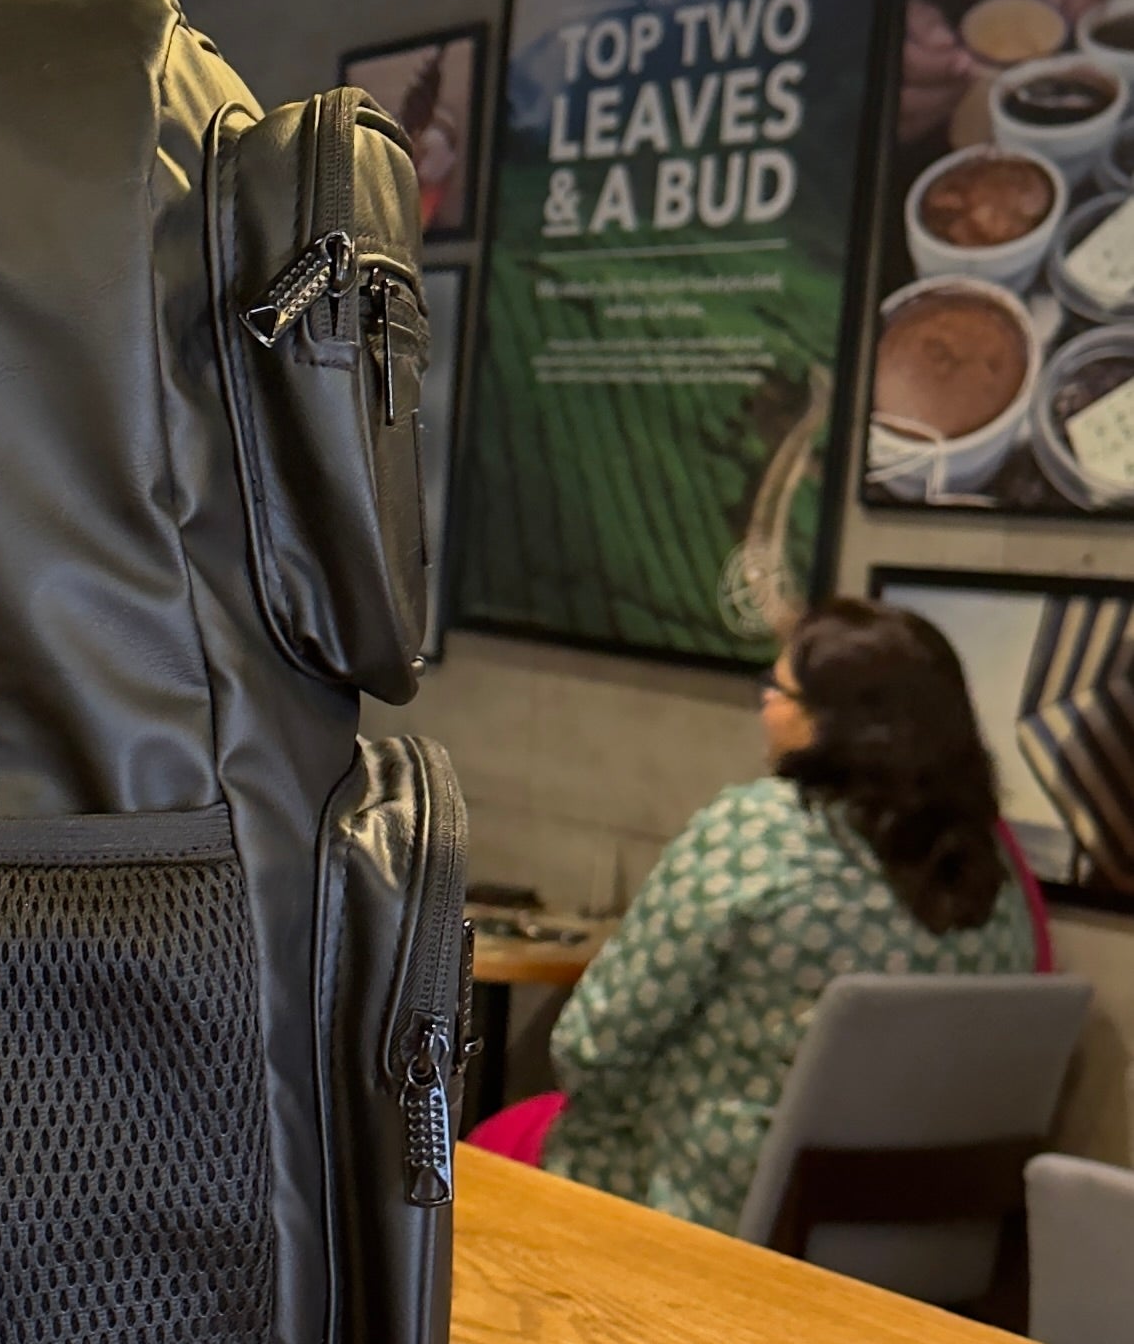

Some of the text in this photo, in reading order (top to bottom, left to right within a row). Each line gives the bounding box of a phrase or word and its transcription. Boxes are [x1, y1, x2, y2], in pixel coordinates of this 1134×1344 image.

[559, 14, 663, 83] TOP
[549, 61, 806, 160] LEAVES
[542, 149, 796, 236] & A BUD
